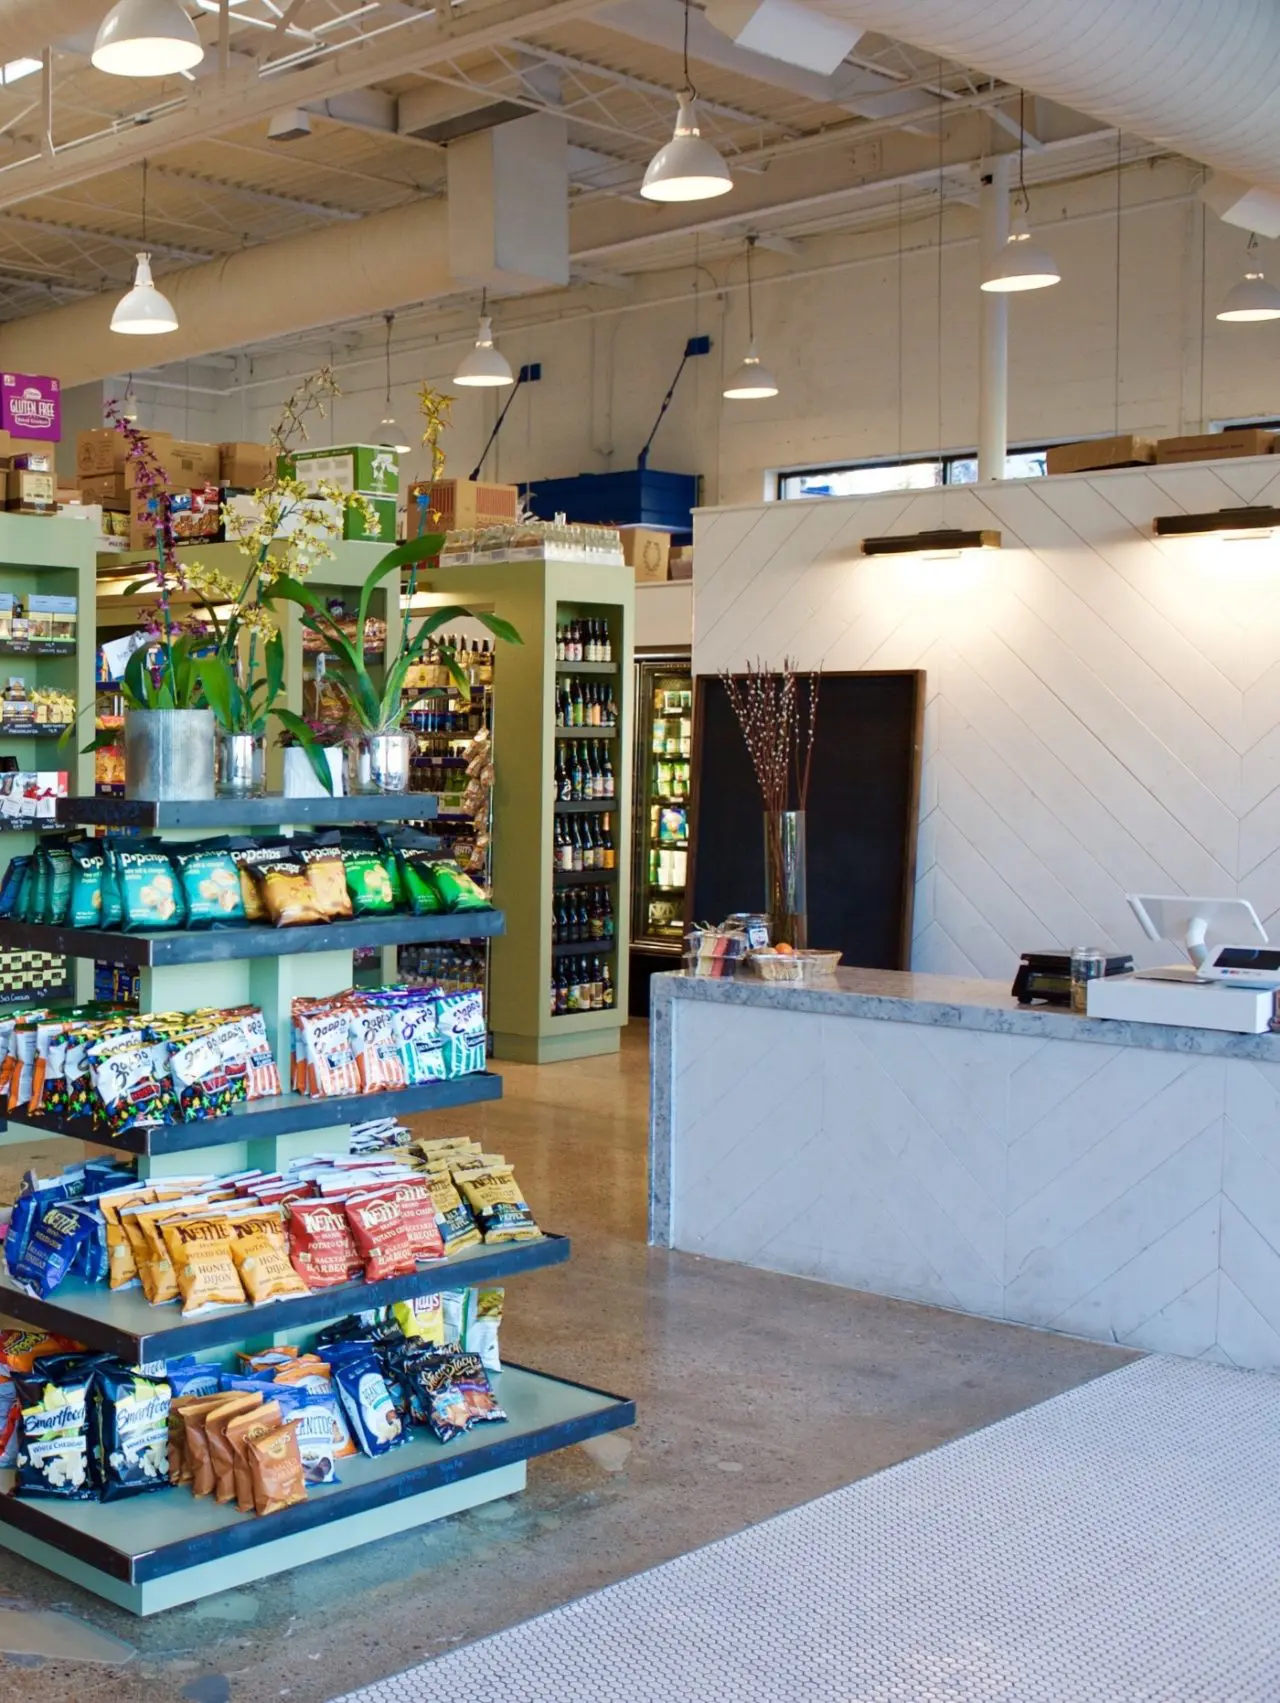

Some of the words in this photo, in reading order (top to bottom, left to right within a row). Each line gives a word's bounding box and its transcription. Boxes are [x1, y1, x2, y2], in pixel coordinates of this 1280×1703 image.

[9, 399, 38, 416] GLUTEN
[39, 402, 56, 417] FREE
[121, 852, 169, 867] popchips
[175, 1221, 230, 1244] KETTLE
[198, 1263, 232, 1275] HONEY
[266, 1262, 290, 1275] DIJON
[204, 1273, 232, 1285] DIJON
[23, 1403, 86, 1430] Smartfood
[33, 1442, 53, 1454] WHITE
